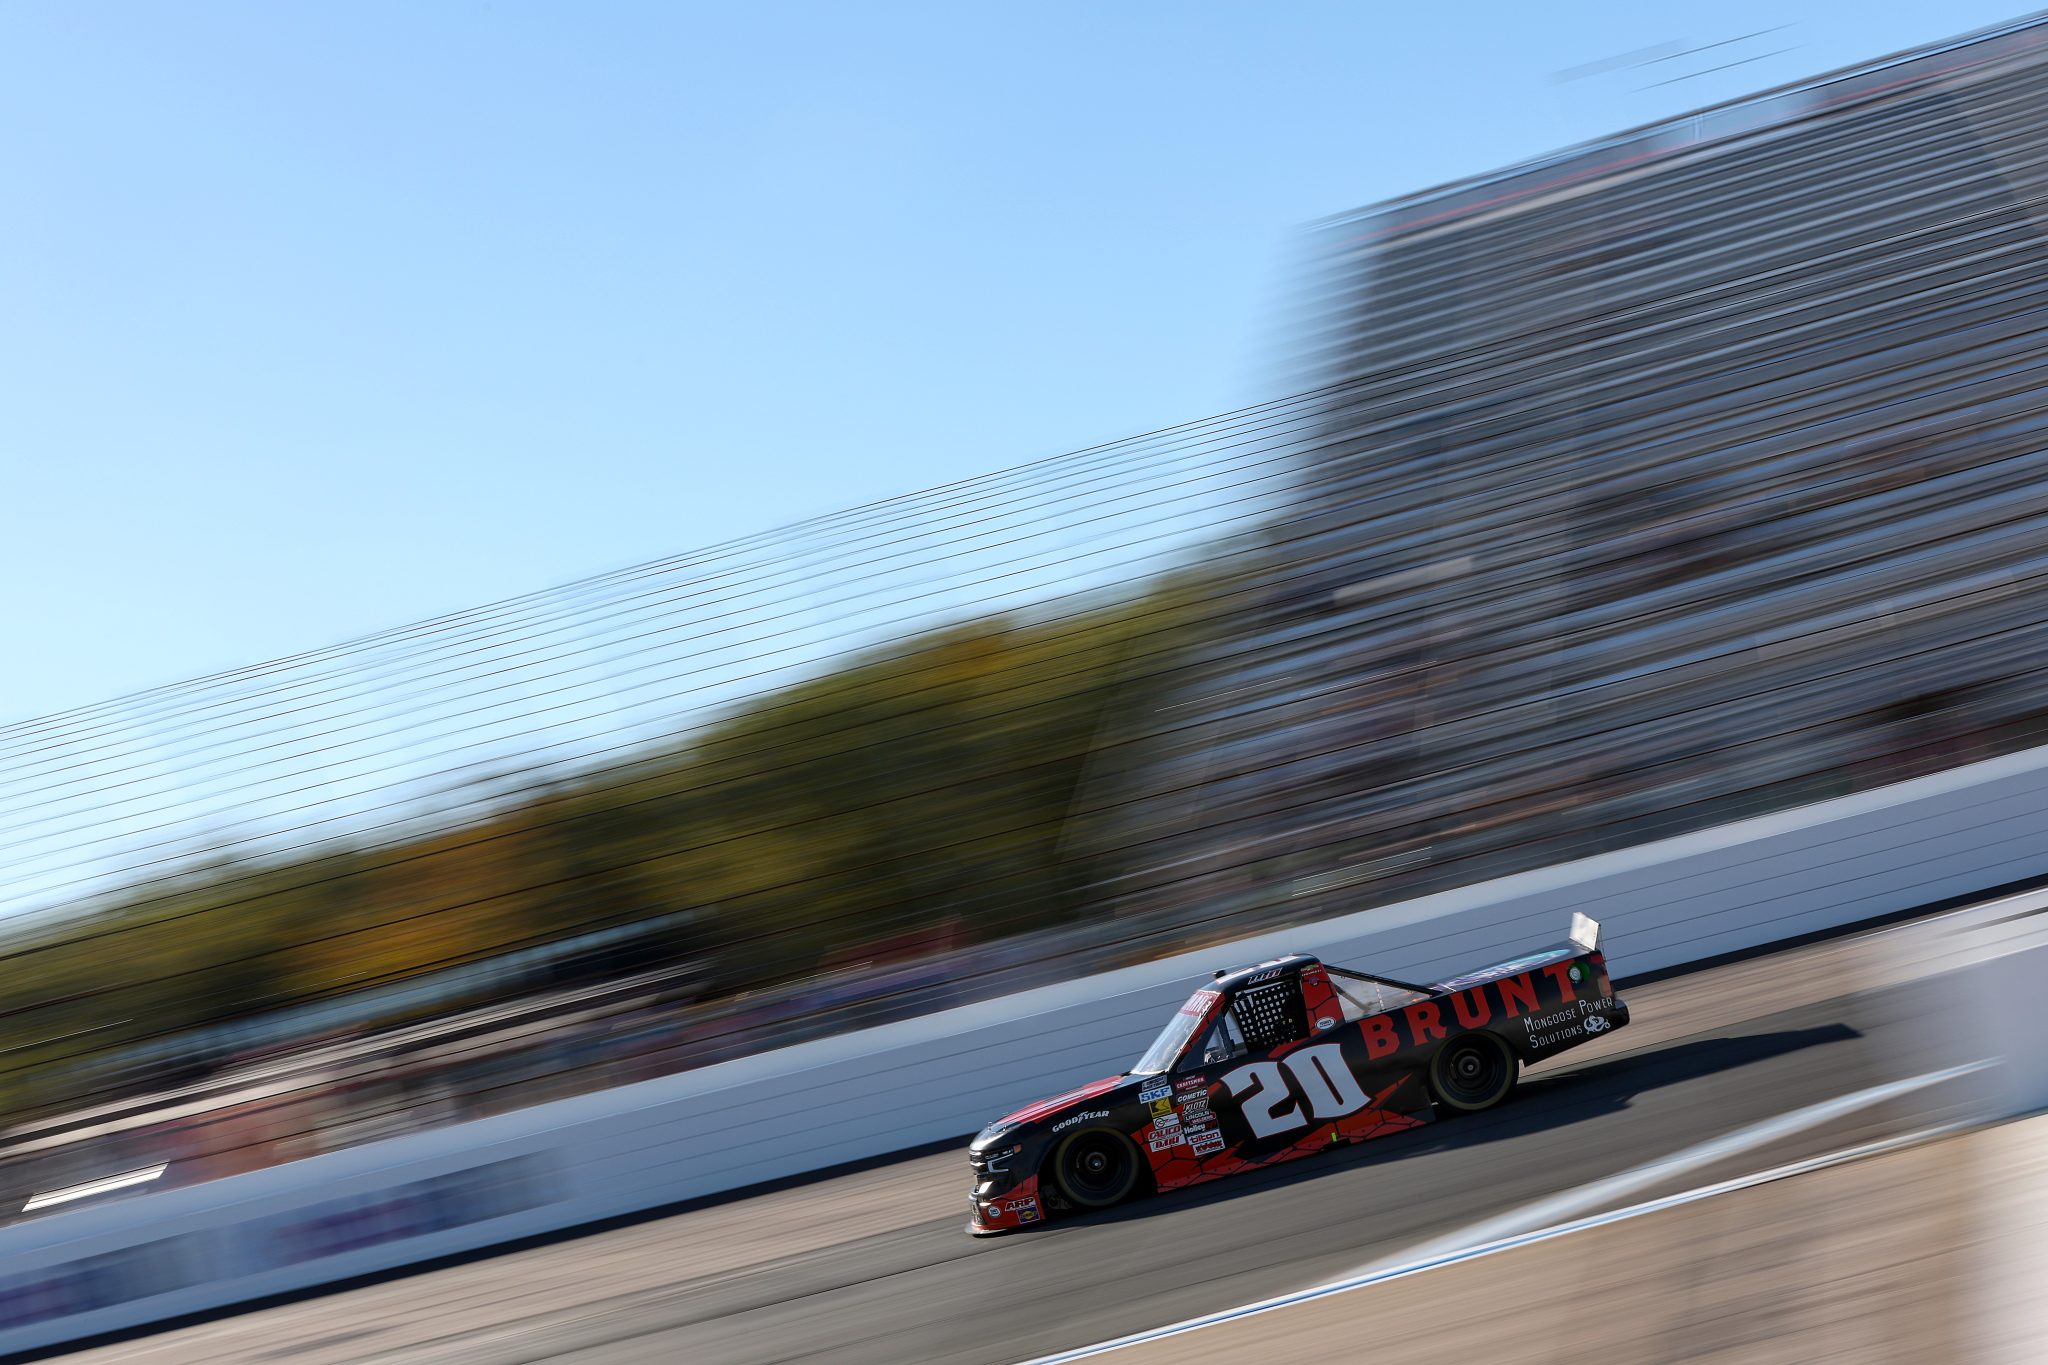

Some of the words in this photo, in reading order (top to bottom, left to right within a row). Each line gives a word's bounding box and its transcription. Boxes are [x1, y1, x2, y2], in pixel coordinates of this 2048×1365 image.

[1357, 960, 1576, 1060] BRUNT
[1142, 1087, 1170, 1101] SKF
[1178, 1089, 1207, 1101] COMETIC
[1219, 1043, 1374, 1139] 20
[1052, 1110, 1110, 1133] GOODYEAR
[1185, 1110, 1210, 1121] LINCOLN
[1183, 1123, 1206, 1134] Holley
[1190, 1131, 1219, 1143] tilton
[1005, 1197, 1035, 1210] ARP
